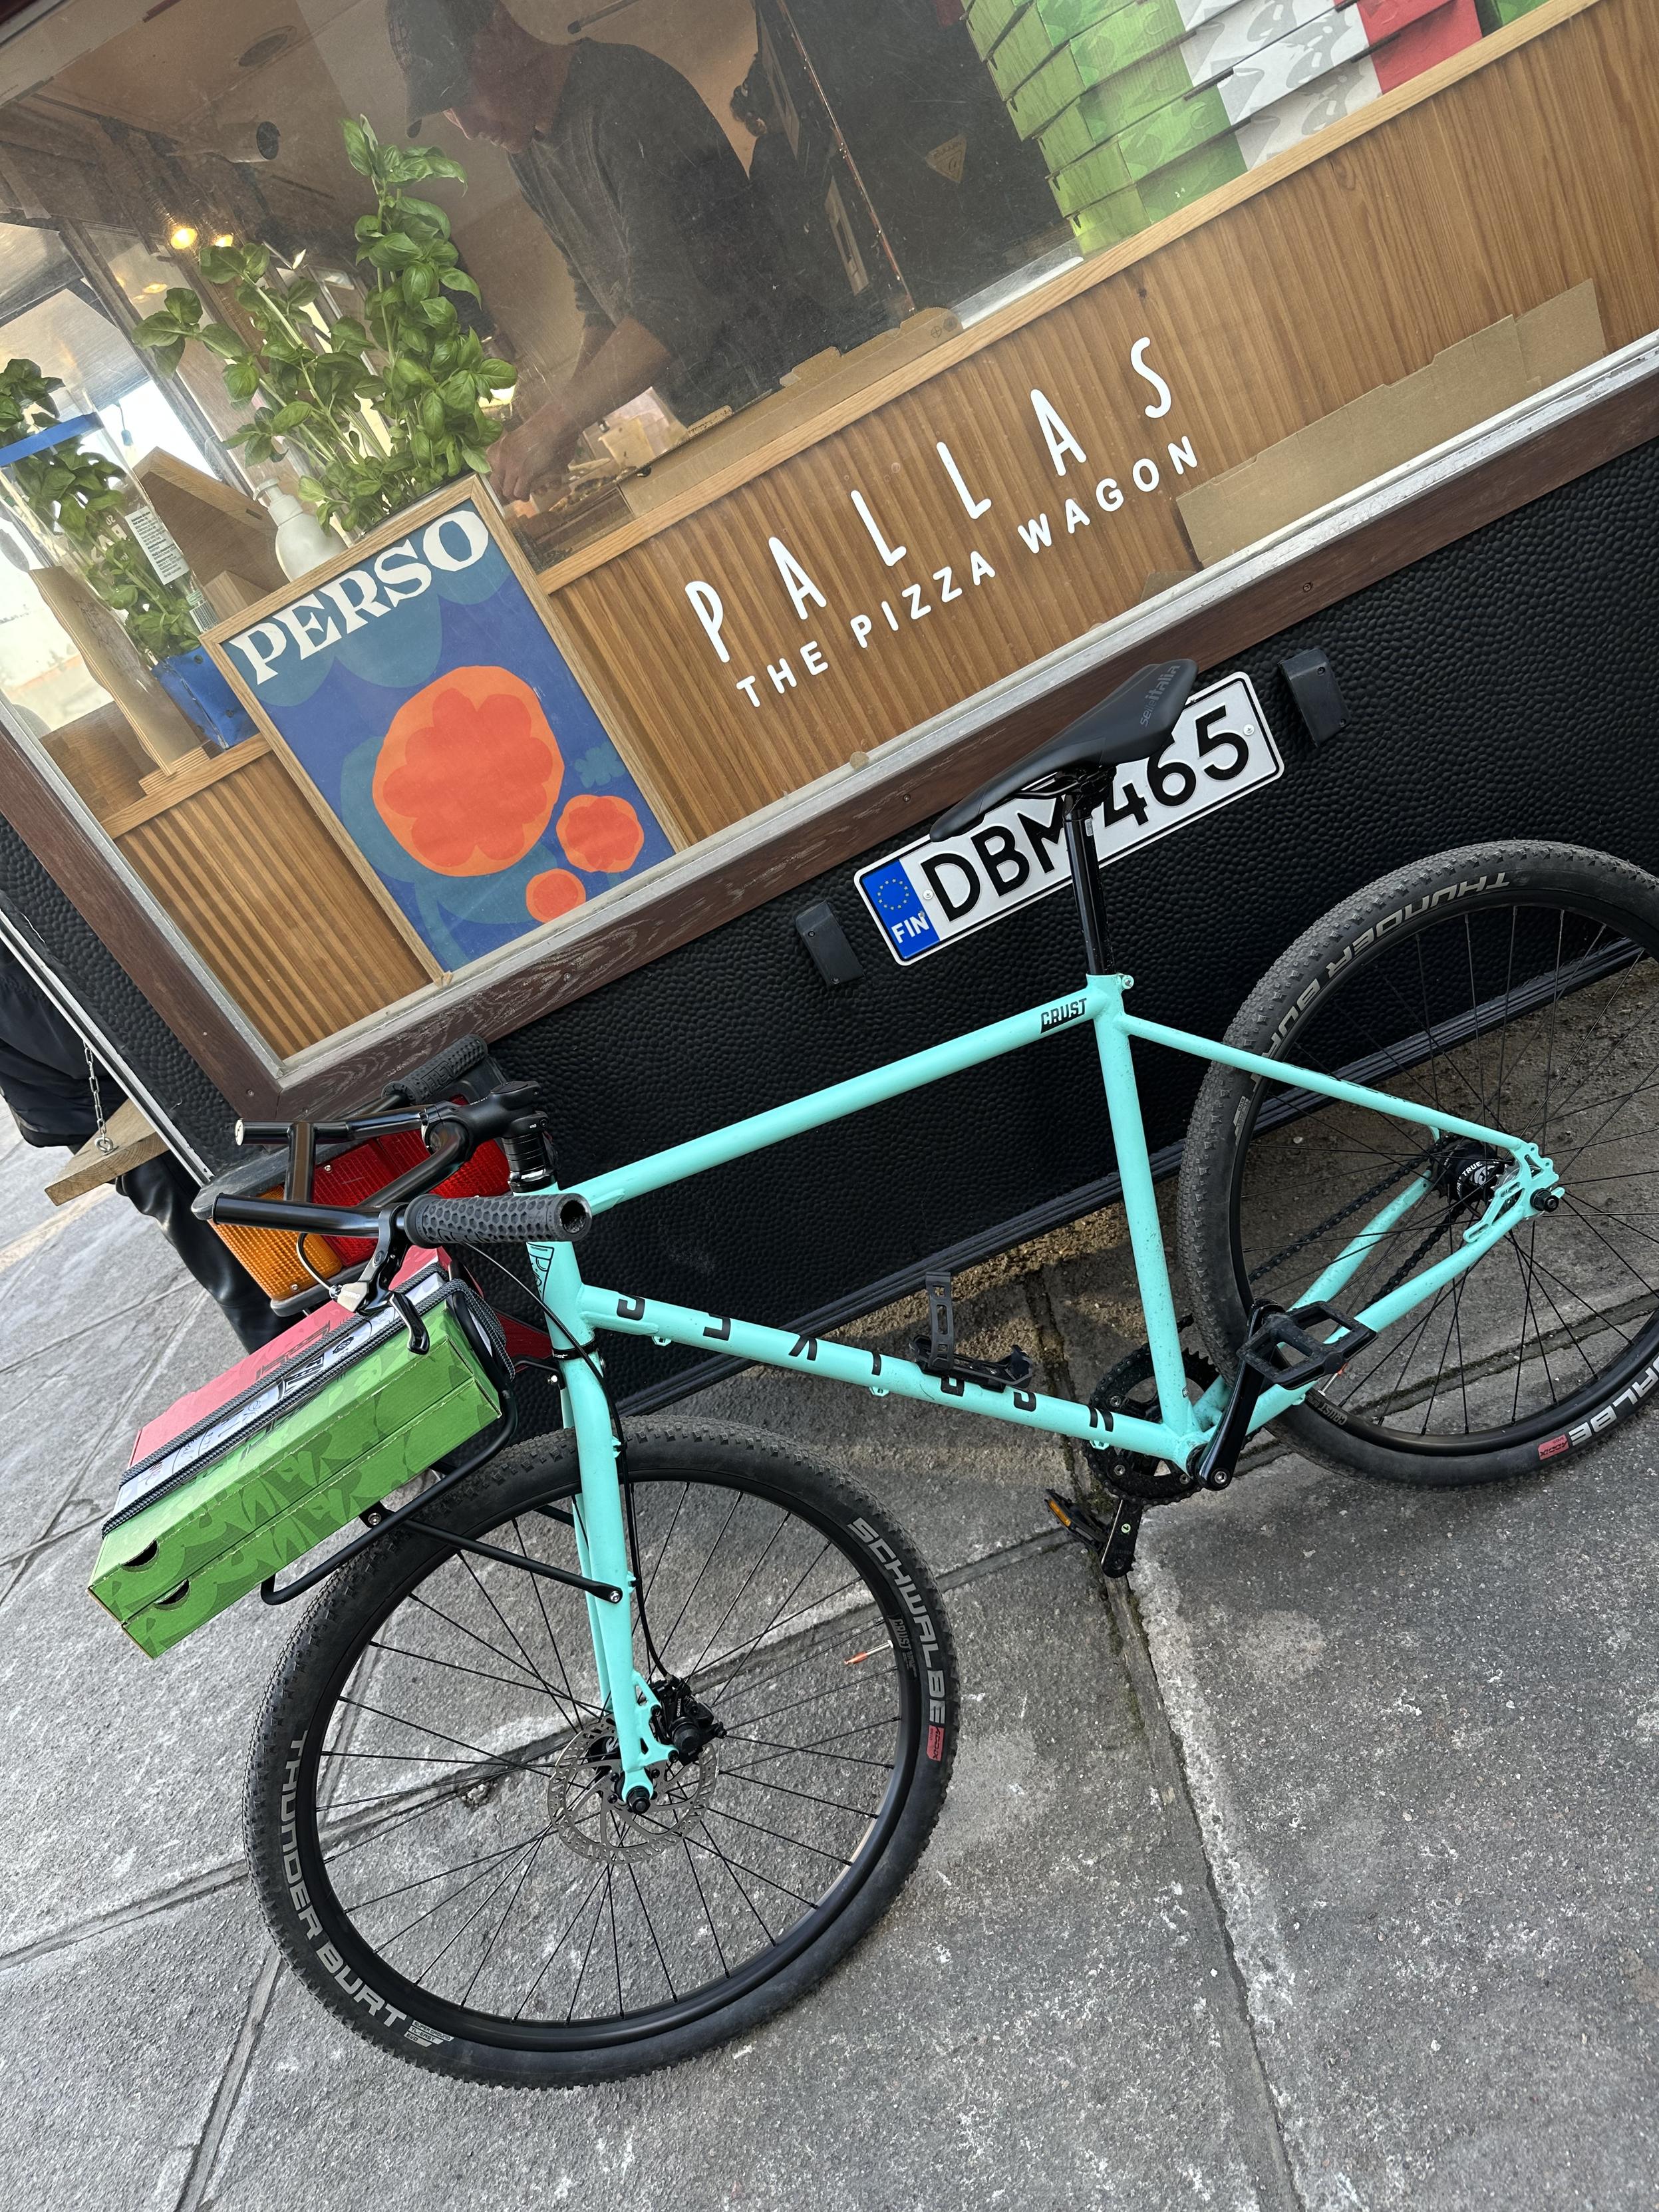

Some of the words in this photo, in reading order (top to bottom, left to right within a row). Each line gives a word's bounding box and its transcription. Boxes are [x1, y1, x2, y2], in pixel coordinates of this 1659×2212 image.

[684, 337, 1171, 663] PALLAS
[736, 640, 829, 707] THE
[849, 550, 996, 649] PIZZA
[1017, 436, 1198, 554] WAGON
[229, 510, 490, 685] PERSO
[891, 914, 929, 943] FIN
[1326, 871, 1511, 983] THUNDER
[1040, 997, 1088, 1033] CRUST
[1461, 1160, 1483, 1177] TRUE
[1317, 1402, 1348, 1426] CRUST
[847, 1517, 946, 1724] SCHWALBE
[887, 1618, 912, 1649] CRUST
[277, 1728, 323, 1939] THUNDER
[315, 1945, 408, 2028] BURT
[406, 2032, 418, 2042] EVO
[413, 2021, 430, 2032] SUPER
